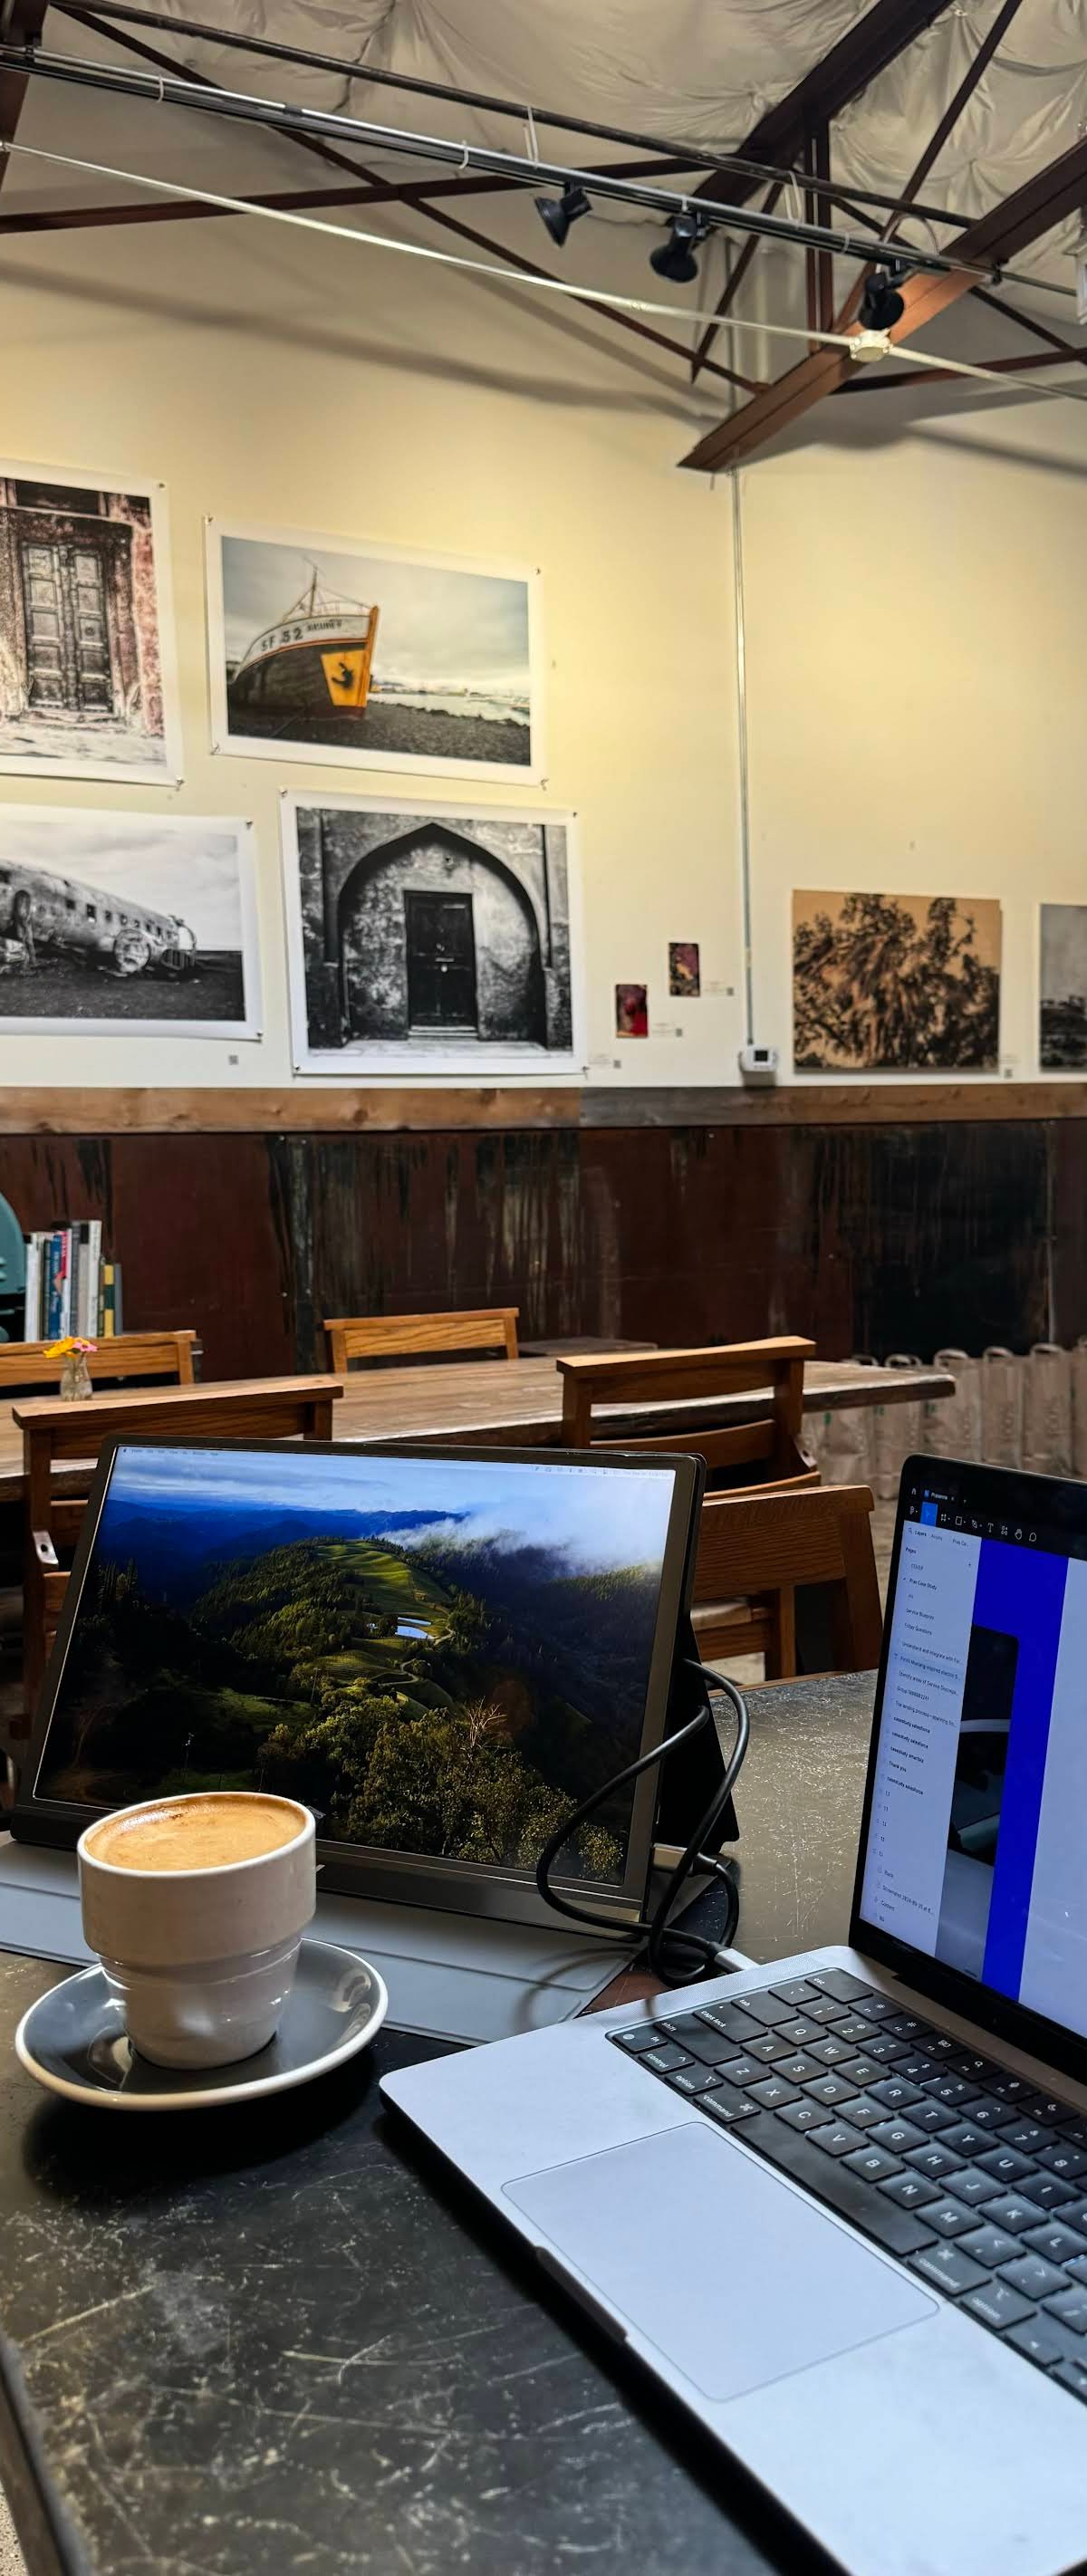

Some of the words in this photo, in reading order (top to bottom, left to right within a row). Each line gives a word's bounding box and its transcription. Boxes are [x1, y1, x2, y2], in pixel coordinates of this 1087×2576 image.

[739, 1999, 751, 2007] tab
[701, 2010, 714, 2020] caps
[714, 2017, 726, 2028] lock
[661, 2022, 677, 2032] shift
[824, 2046, 839, 2054] W
[647, 2053, 669, 2068] control
[736, 2067, 750, 2075] Z
[856, 2067, 870, 2075] E
[676, 2075, 696, 2090] option
[765, 2089, 781, 2097] X
[889, 2089, 902, 2097] R
[703, 2094, 735, 2118] command
[925, 2110, 938, 2119] T
[976, 2110, 989, 2119] 6
[832, 2134, 846, 2142] V
[891, 2131, 905, 2139] G
[962, 2134, 976, 2142] Y
[865, 2158, 880, 2167] B
[927, 2156, 943, 2166] H
[998, 2159, 1015, 2168] U
[1053, 2159, 1068, 2167] 8
[901, 2185, 919, 2195] N
[1041, 2186, 1052, 2194] I
[939, 2211, 958, 2223] M
[1006, 2209, 1023, 2219] K
[1050, 2237, 1063, 2247] L
[919, 2258, 961, 2289] command
[971, 2295, 1001, 2321] option
